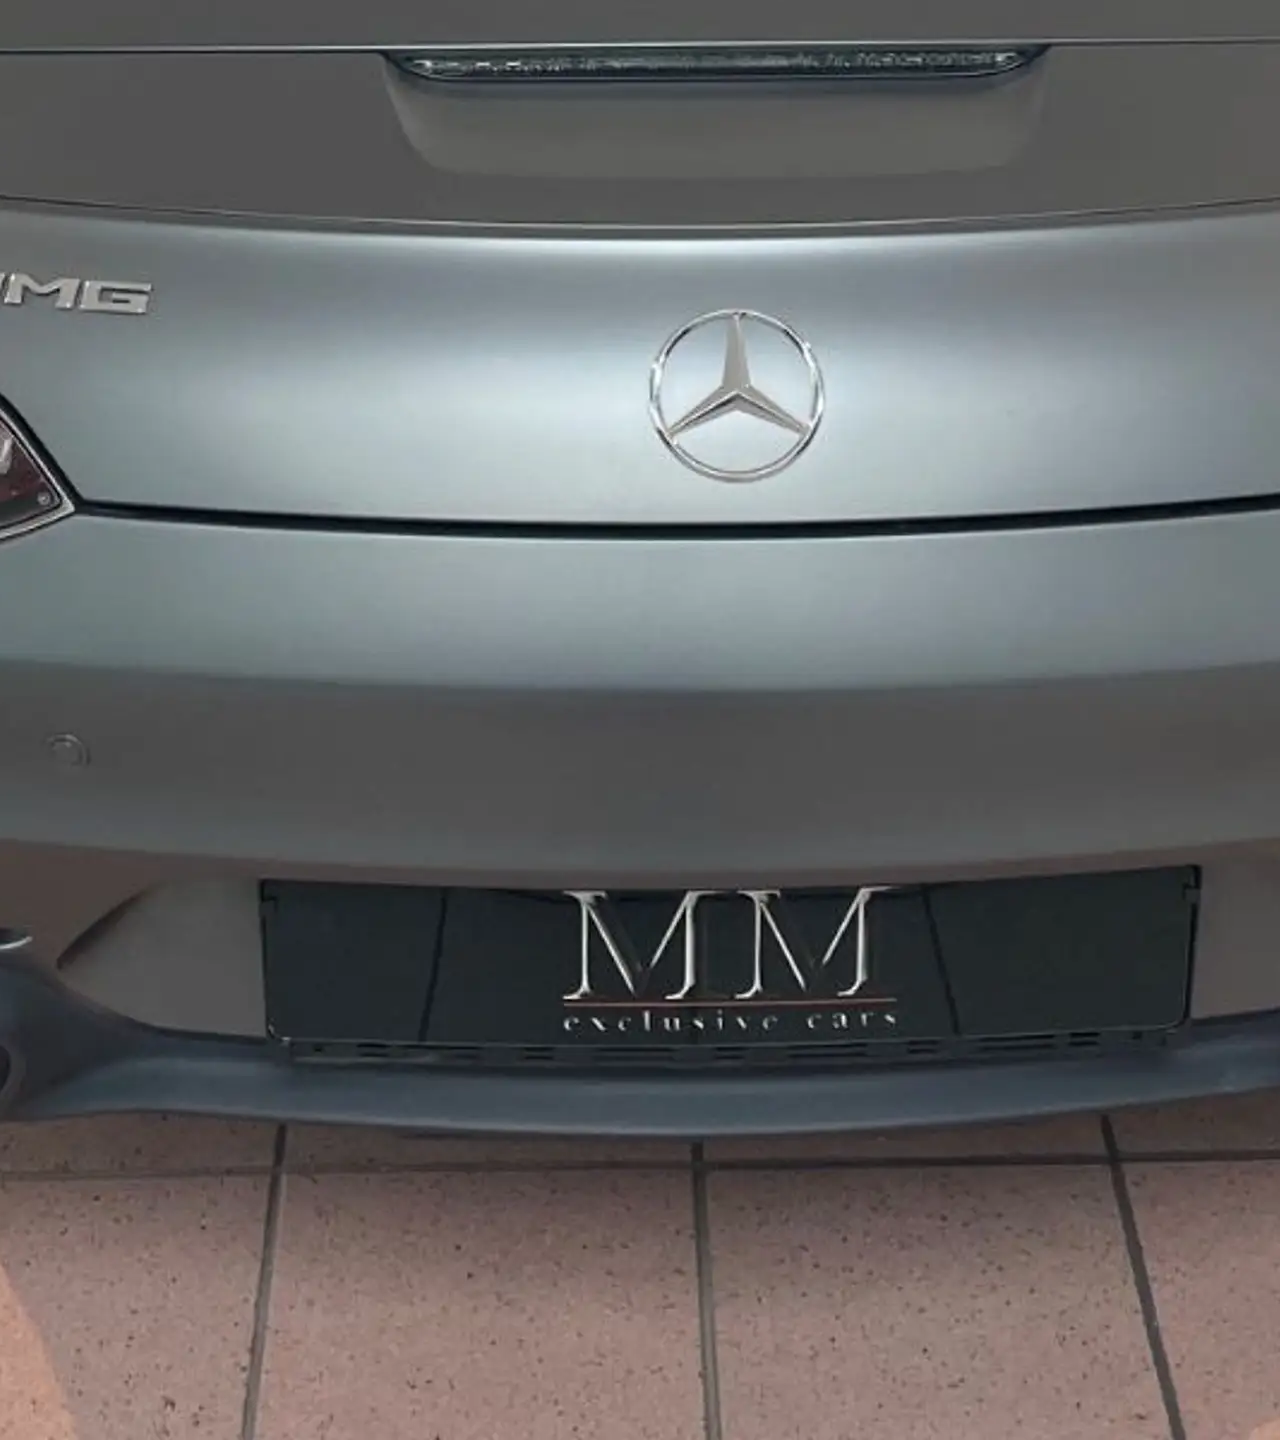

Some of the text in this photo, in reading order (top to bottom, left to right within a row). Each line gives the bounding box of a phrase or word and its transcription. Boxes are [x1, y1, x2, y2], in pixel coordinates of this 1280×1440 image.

[563, 886, 902, 1000] MM
[563, 1009, 898, 1032] exclusive cars
